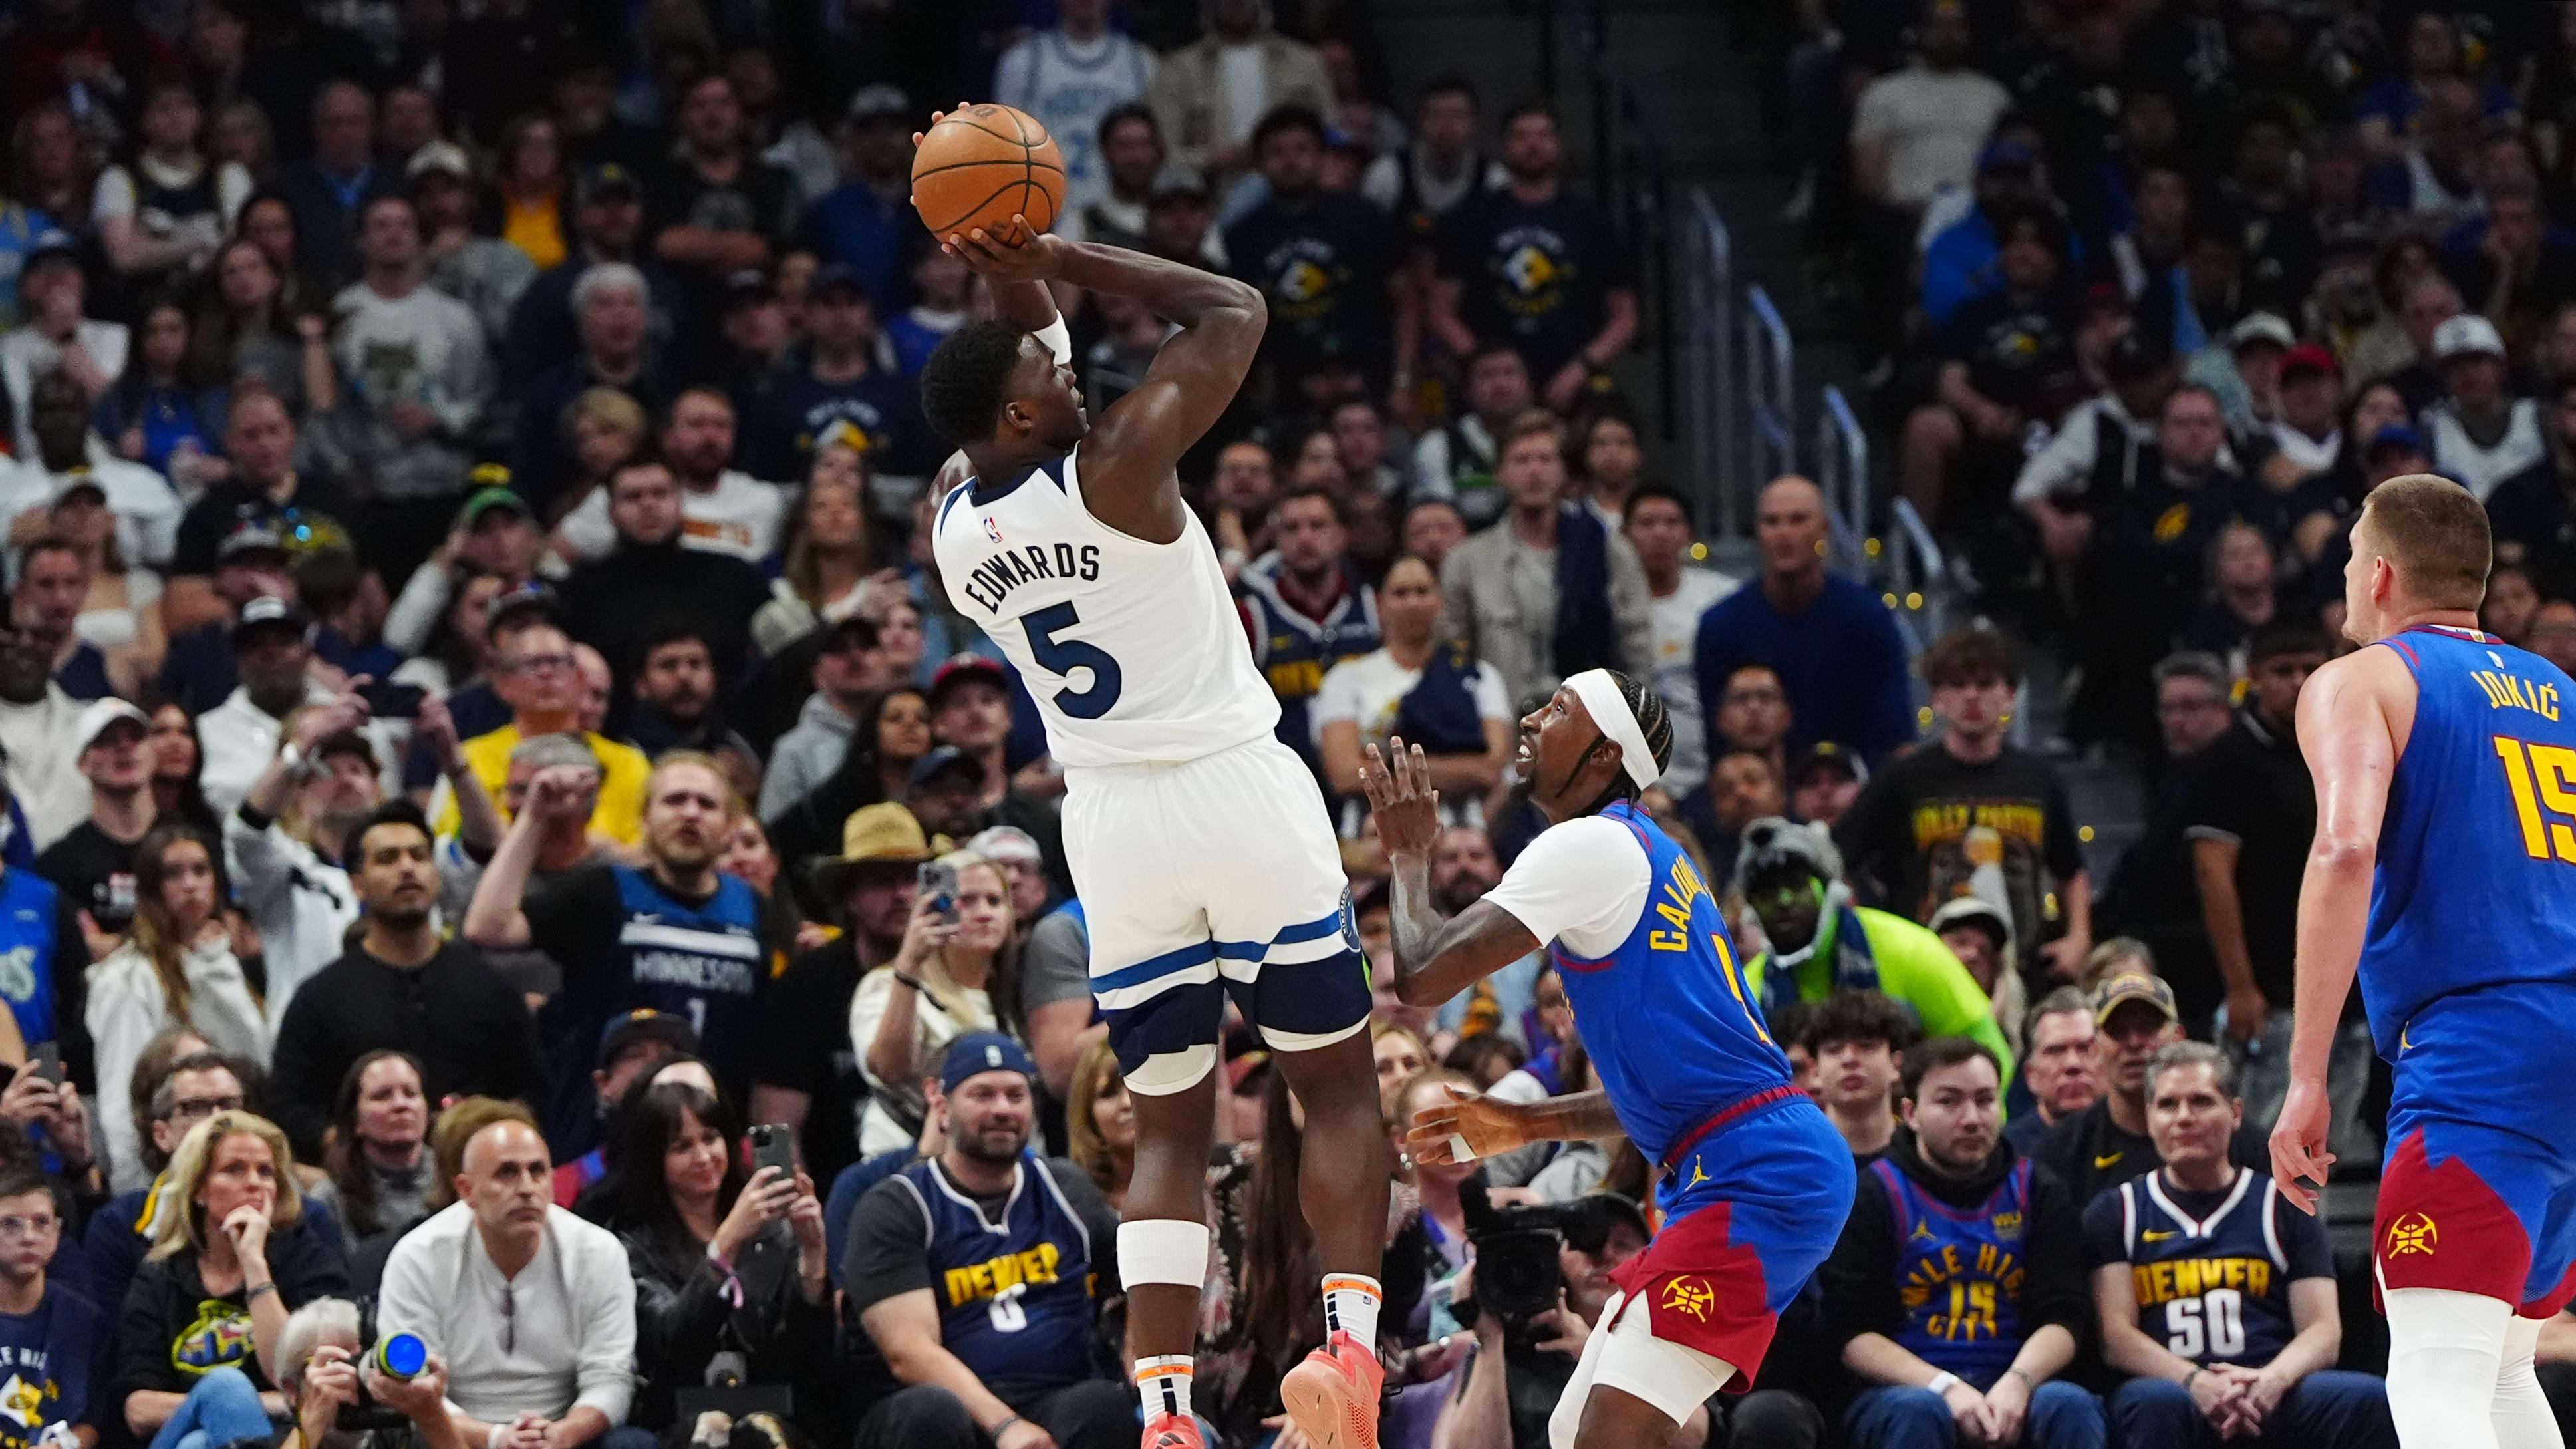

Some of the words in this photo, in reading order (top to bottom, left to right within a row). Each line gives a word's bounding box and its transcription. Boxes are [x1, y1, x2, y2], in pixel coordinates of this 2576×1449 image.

[964, 542, 1099, 615] EDWARDS
[1018, 599, 1122, 719] 5
[2470, 670, 2559, 721] JOKIĆ
[2492, 734, 2576, 864] 15
[2133, 1258, 2271, 1307] DENVER
[2165, 1287, 2245, 1359] 50
